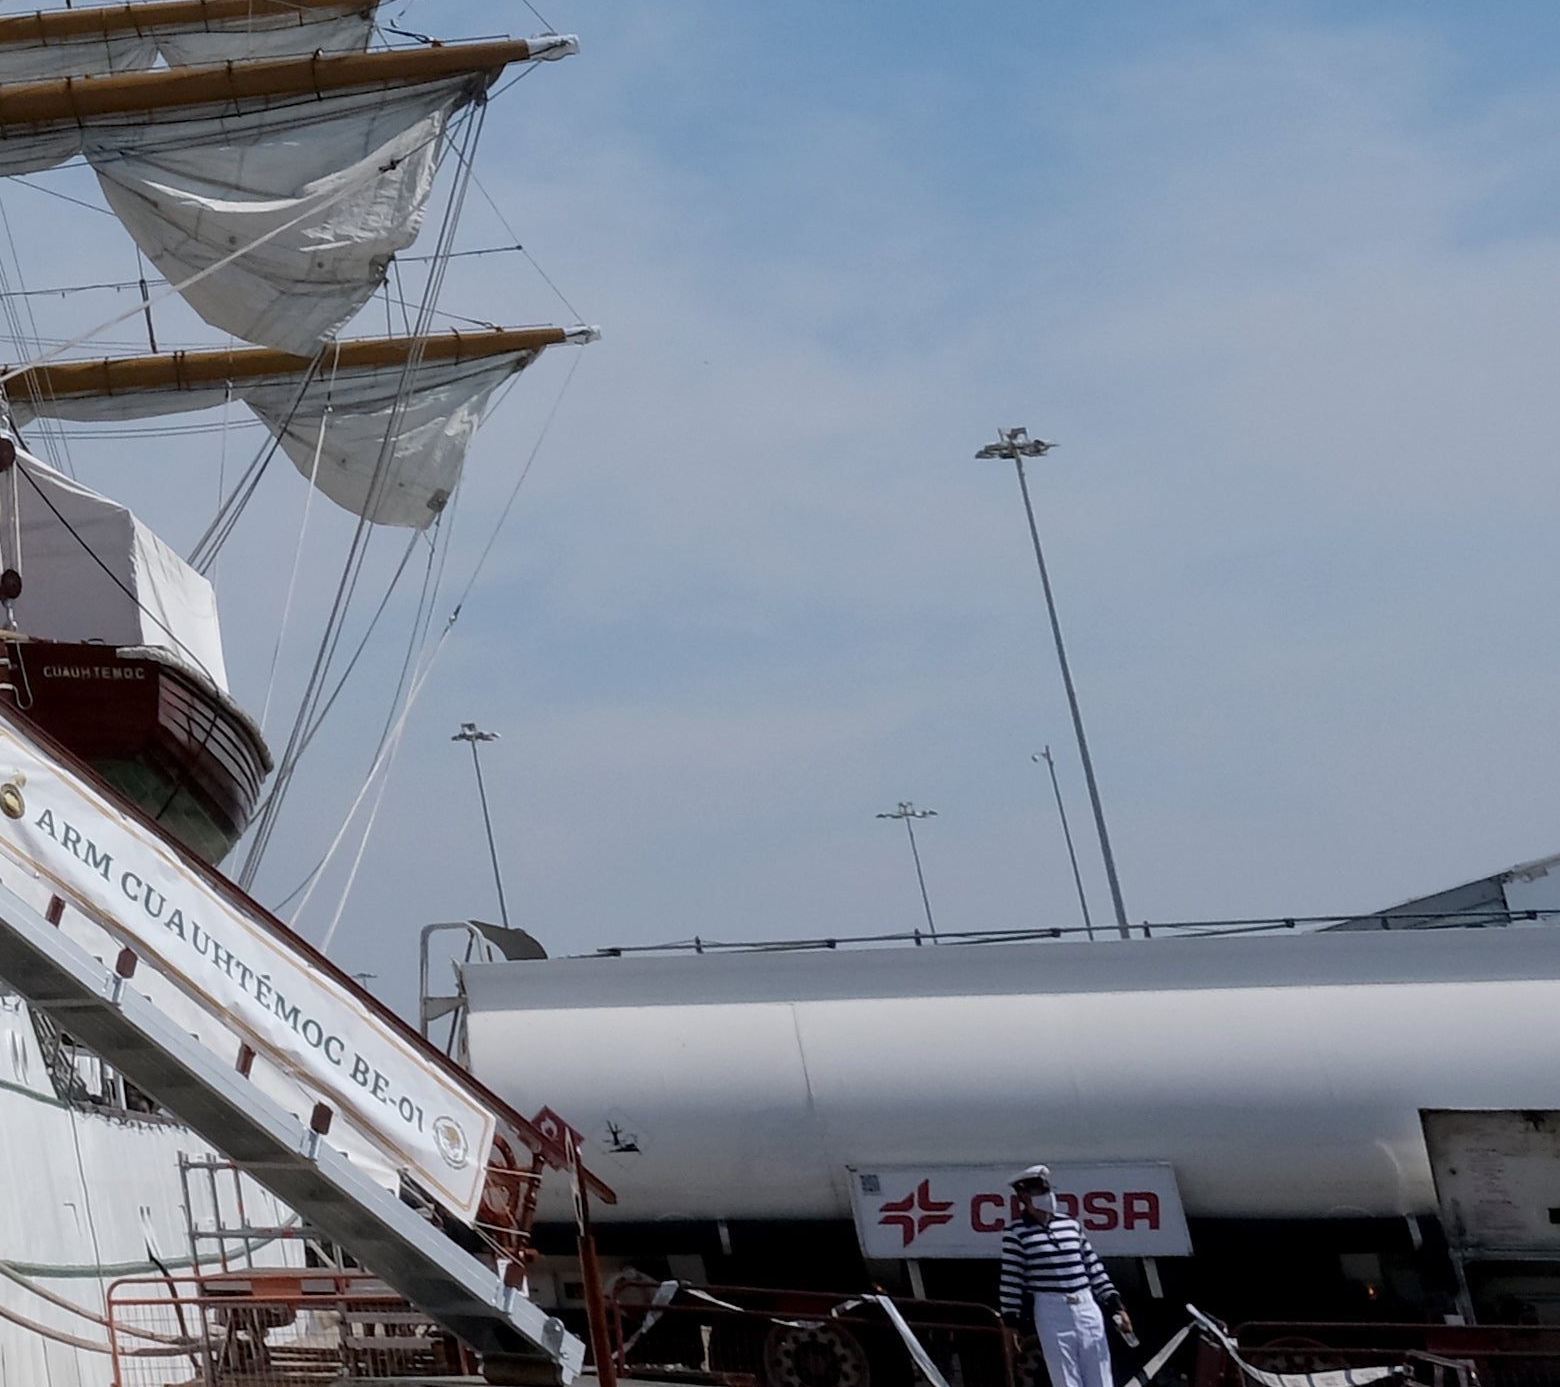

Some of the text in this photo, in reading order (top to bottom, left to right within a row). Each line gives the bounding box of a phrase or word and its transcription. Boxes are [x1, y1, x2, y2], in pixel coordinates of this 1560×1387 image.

[43, 665, 145, 680] CUAUHTEMOC
[34, 808, 424, 1133] ARM CUAUHTÉMOC BE-01
[970, 1190, 1161, 1233] CSA
